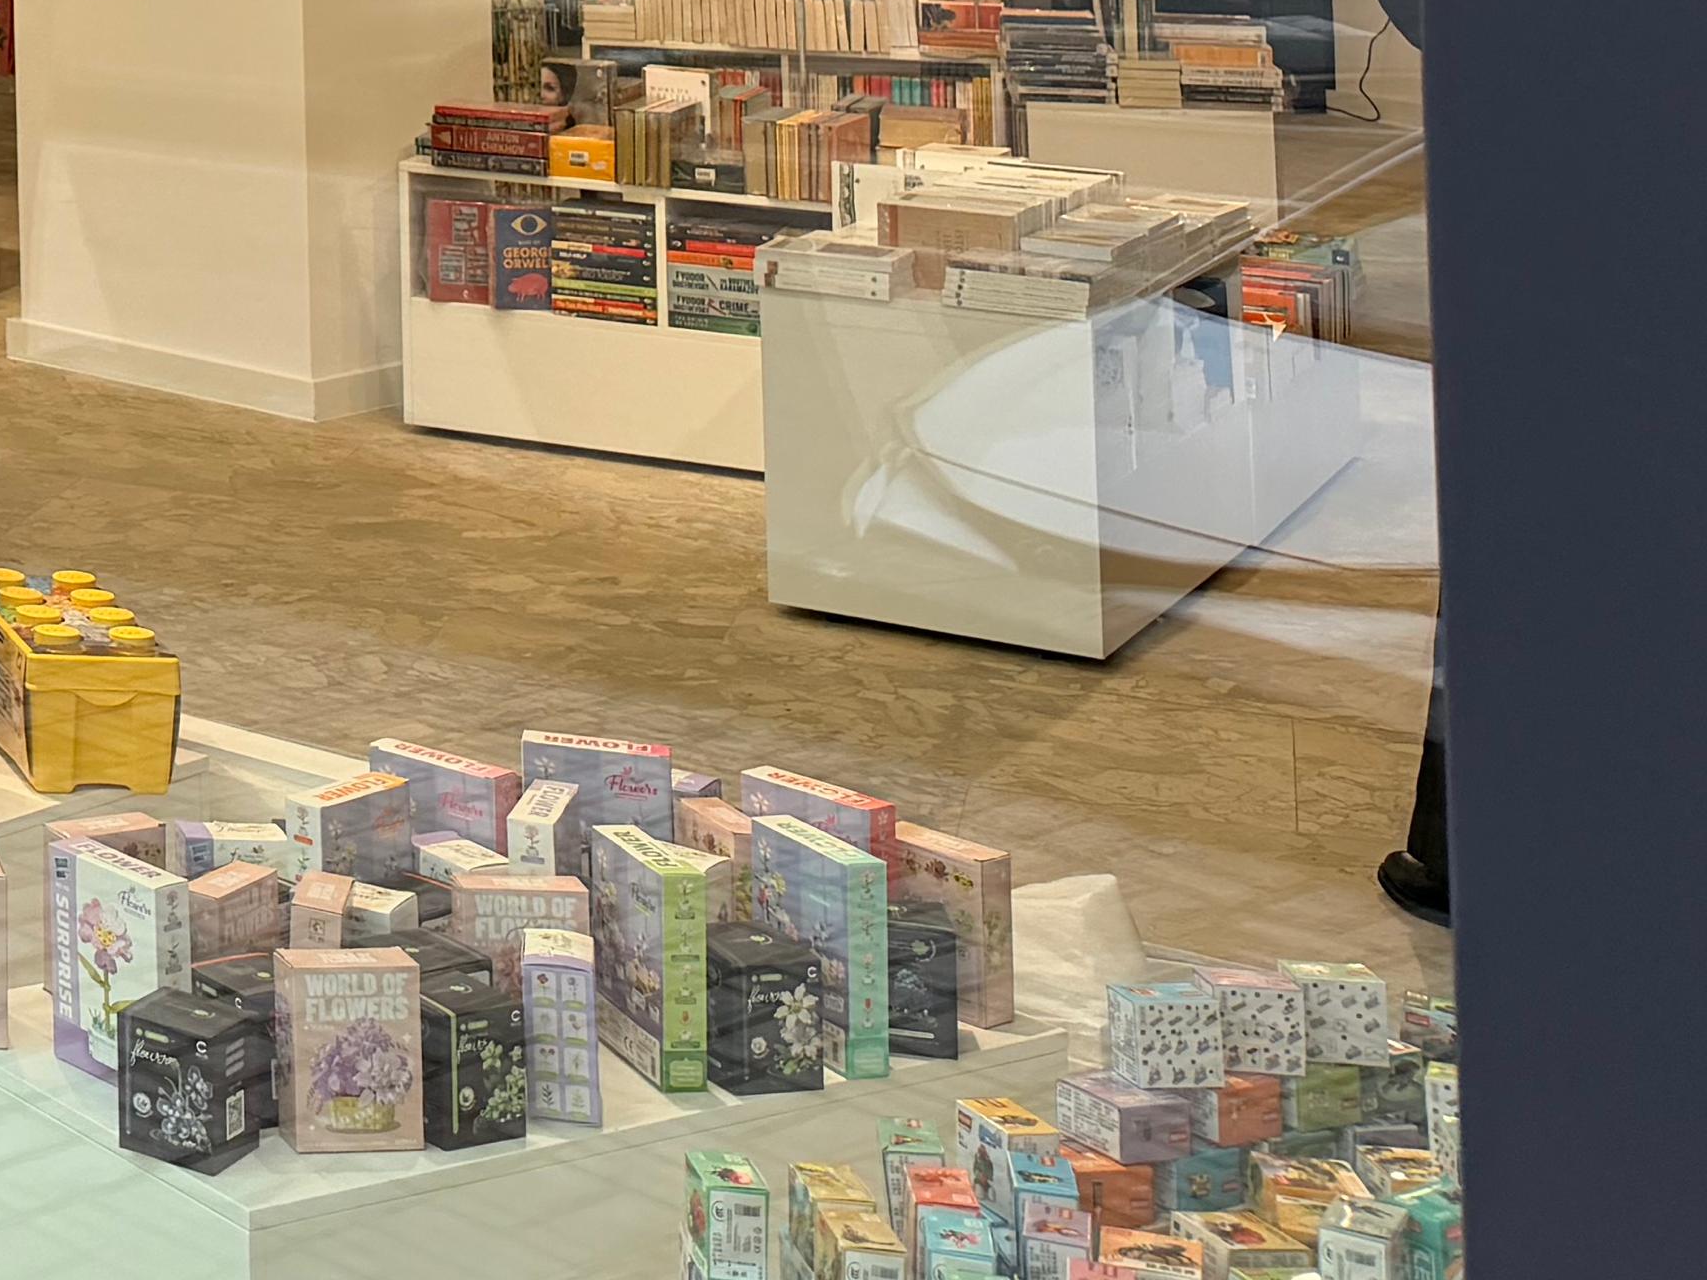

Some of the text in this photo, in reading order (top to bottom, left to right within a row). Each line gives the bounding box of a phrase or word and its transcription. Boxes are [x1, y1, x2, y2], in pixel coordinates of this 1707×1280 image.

[481, 141, 525, 155] CHEKHOV
[487, 131, 520, 144] ANTON
[503, 258, 550, 270] ORWEL
[719, 300, 749, 312] CRIME
[544, 735, 648, 753] FLOWER
[395, 742, 488, 773] FLOWER
[313, 778, 389, 802] FLOWER
[75, 842, 161, 880] FLOWER
[613, 831, 677, 870] FLOWER
[475, 895, 578, 918] WORLD OF
[55, 891, 74, 1019] SURPRISE
[304, 972, 409, 998] WORLD OF
[305, 997, 410, 1023] FLOWERS
